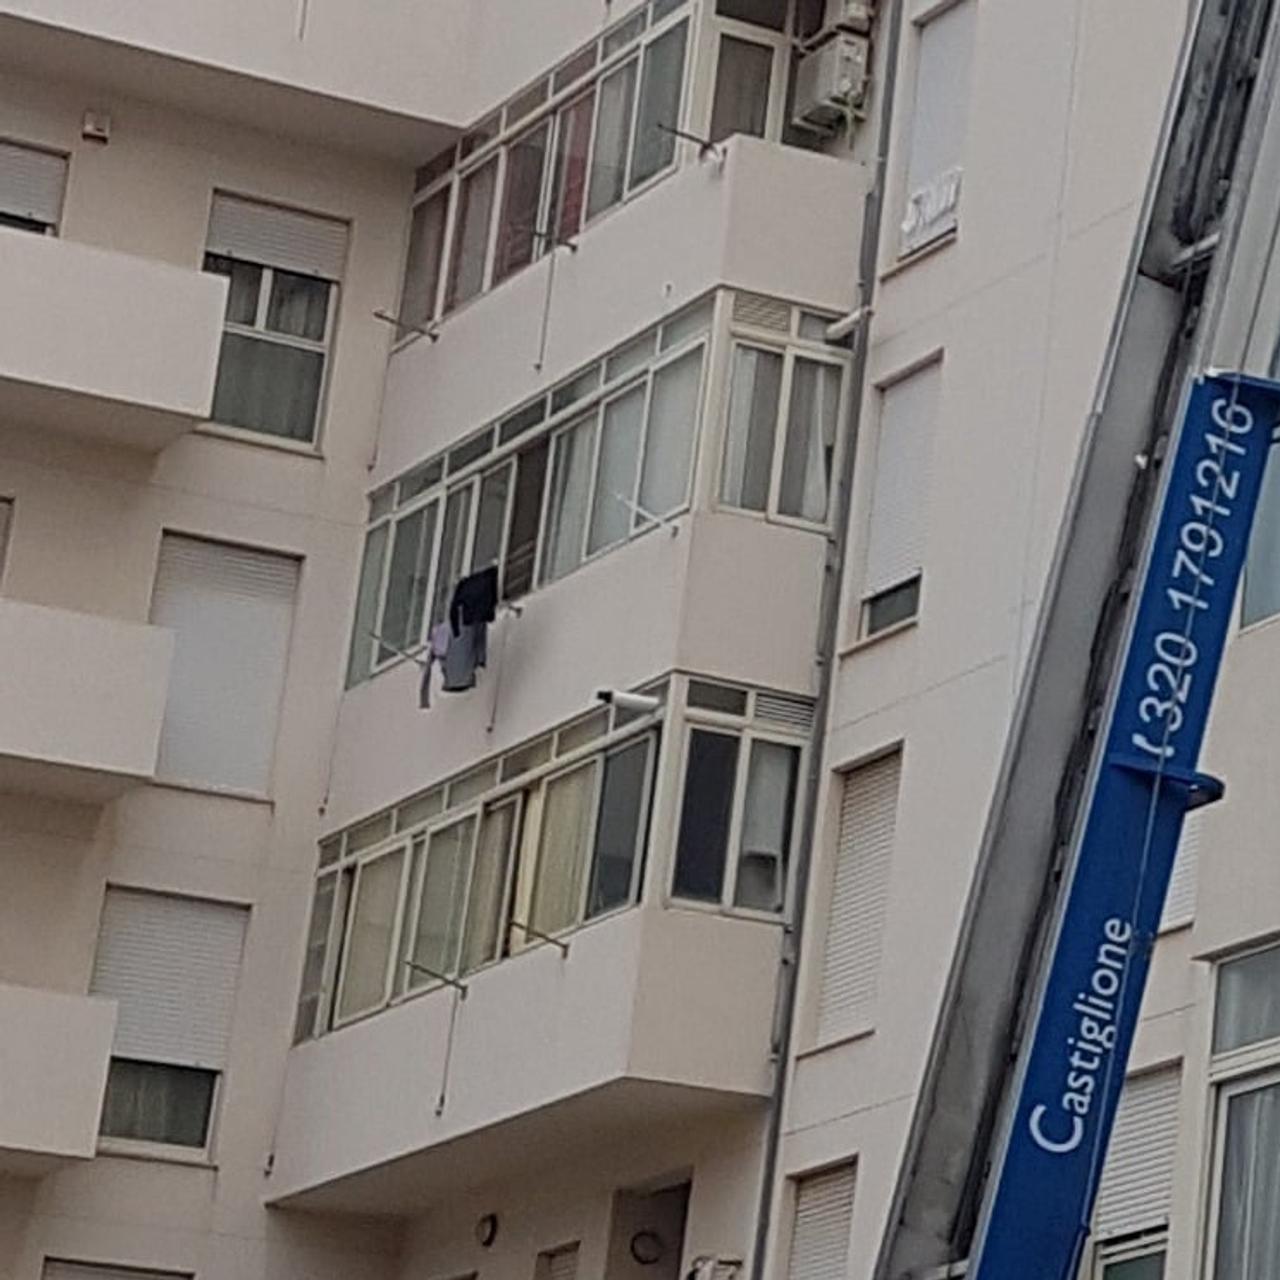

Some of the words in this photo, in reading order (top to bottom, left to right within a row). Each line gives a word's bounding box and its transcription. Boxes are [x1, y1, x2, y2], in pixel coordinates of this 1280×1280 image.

[1168, 398, 1254, 610] 1791216
[1139, 631, 1199, 732] 320
[1029, 917, 1132, 1154] Castiglione
